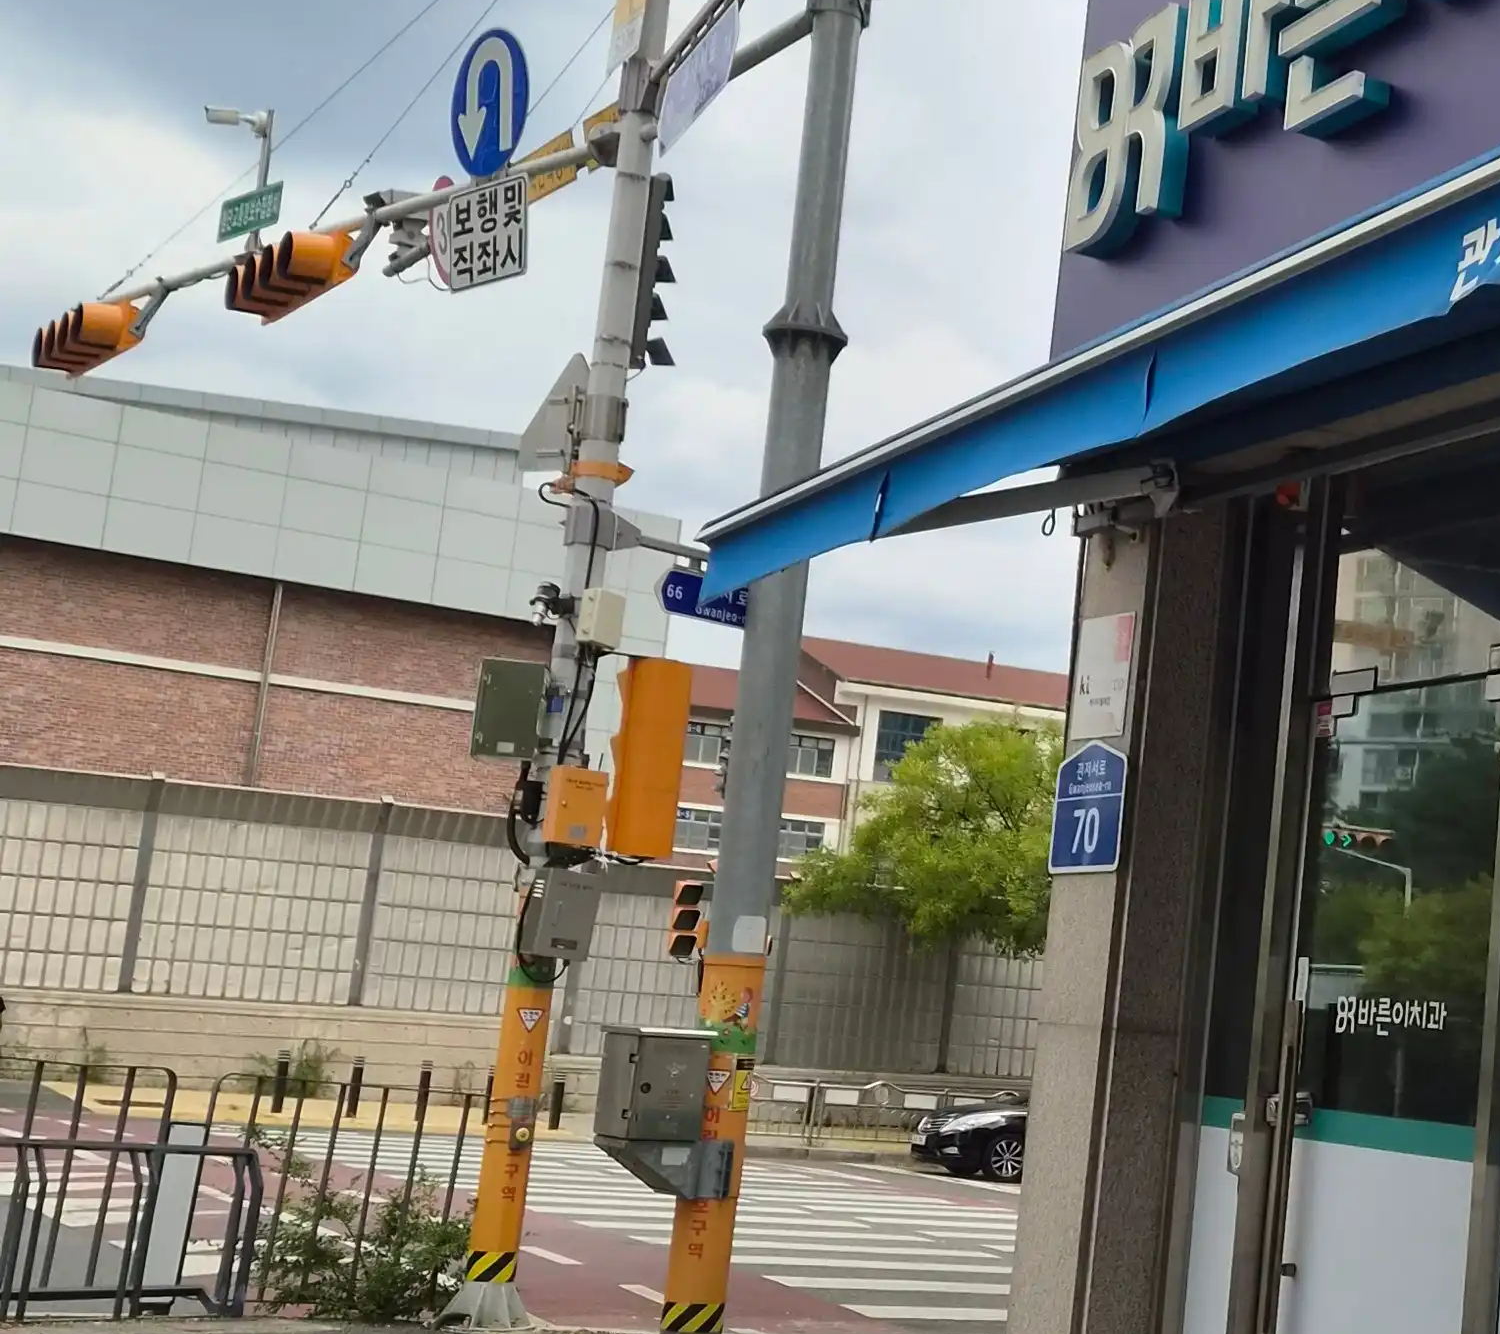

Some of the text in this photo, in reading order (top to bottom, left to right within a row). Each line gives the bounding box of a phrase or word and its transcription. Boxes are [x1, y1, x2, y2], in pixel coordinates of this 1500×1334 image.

[452, 228, 524, 284] 직좌시
[666, 583, 684, 601] 66
[1075, 759, 1107, 781] 관저서로
[1071, 806, 1100, 855] 70
[1357, 996, 1448, 1037] 바른이치과
